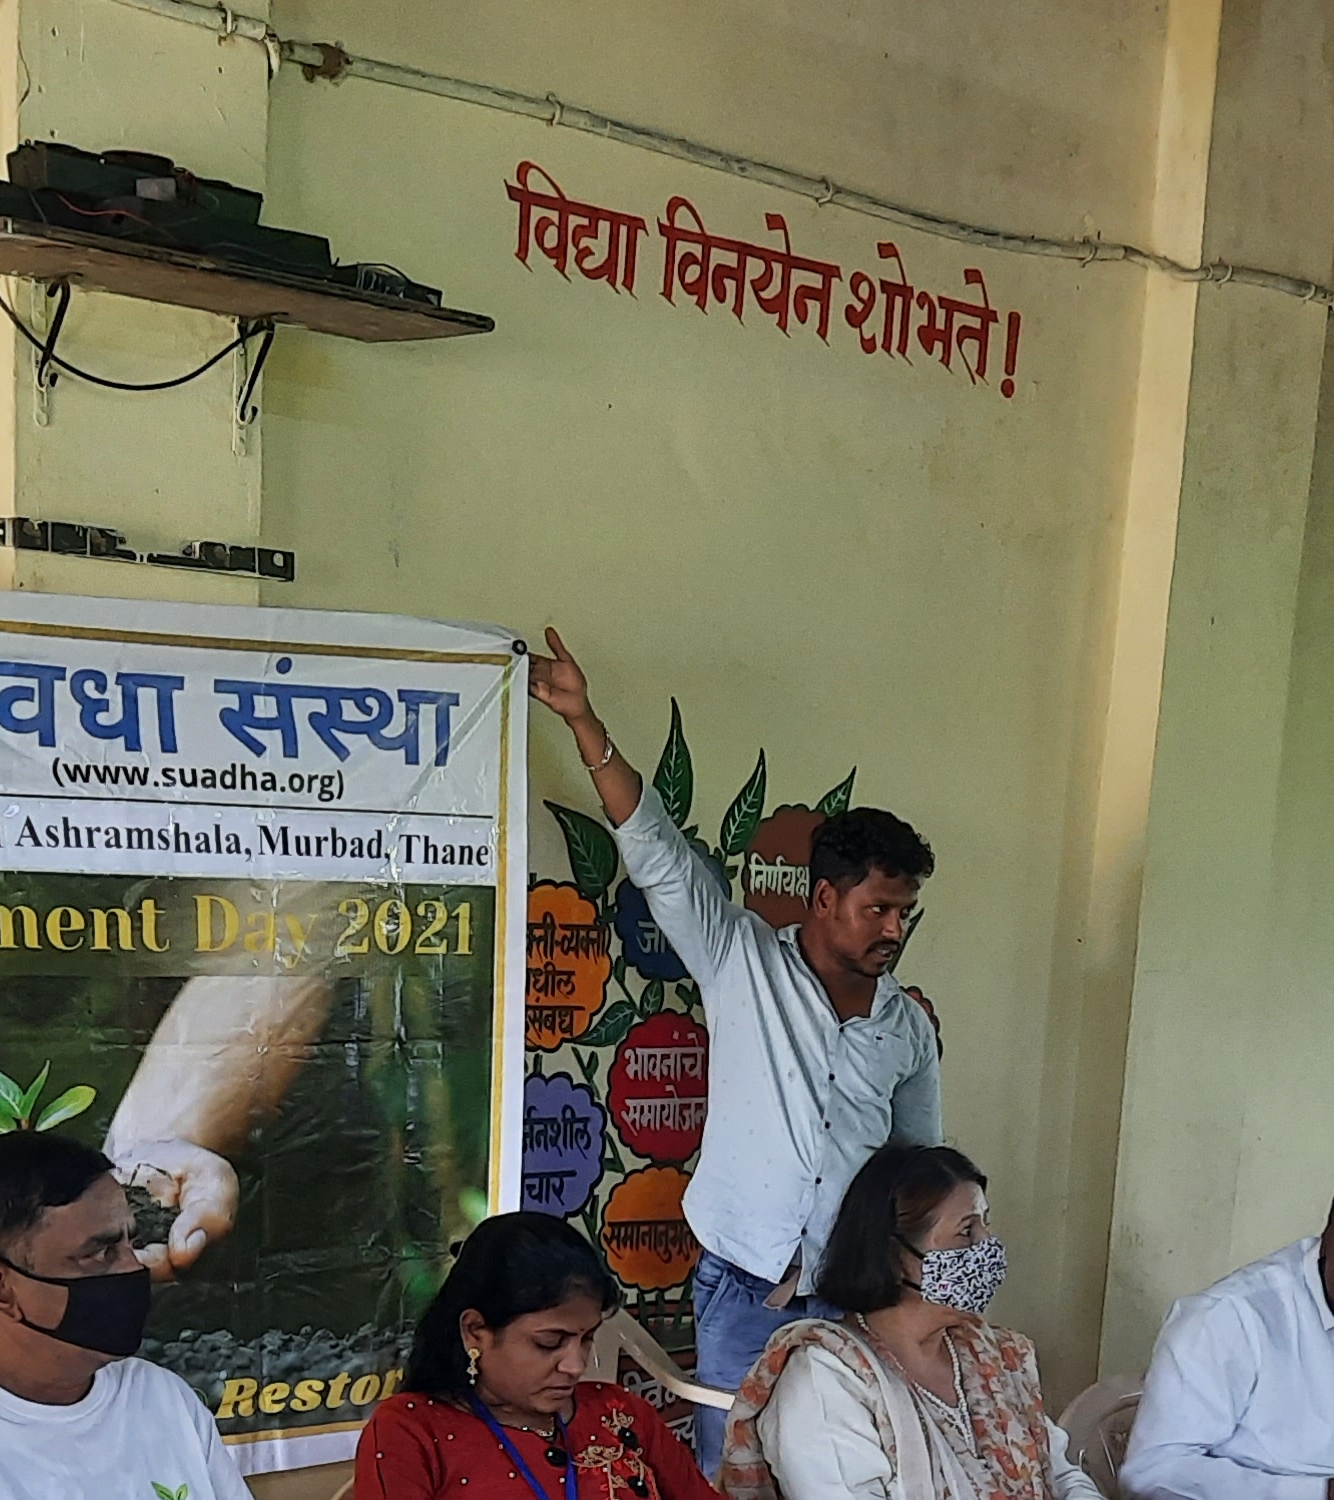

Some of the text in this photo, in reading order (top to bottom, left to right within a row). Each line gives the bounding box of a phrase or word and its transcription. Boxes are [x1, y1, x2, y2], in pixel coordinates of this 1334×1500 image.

[504, 160, 650, 300] विद्या
[656, 196, 842, 348] विनयेन
[213, 656, 461, 768] संस्था
[52, 757, 345, 803] (www.suadha.org)
[398, 834, 490, 867] Thane
[193, 894, 319, 966] Day
[334, 898, 475, 958] 2021
[524, 1169, 578, 1206] चार
[214, 1366, 405, 1419] Restor
